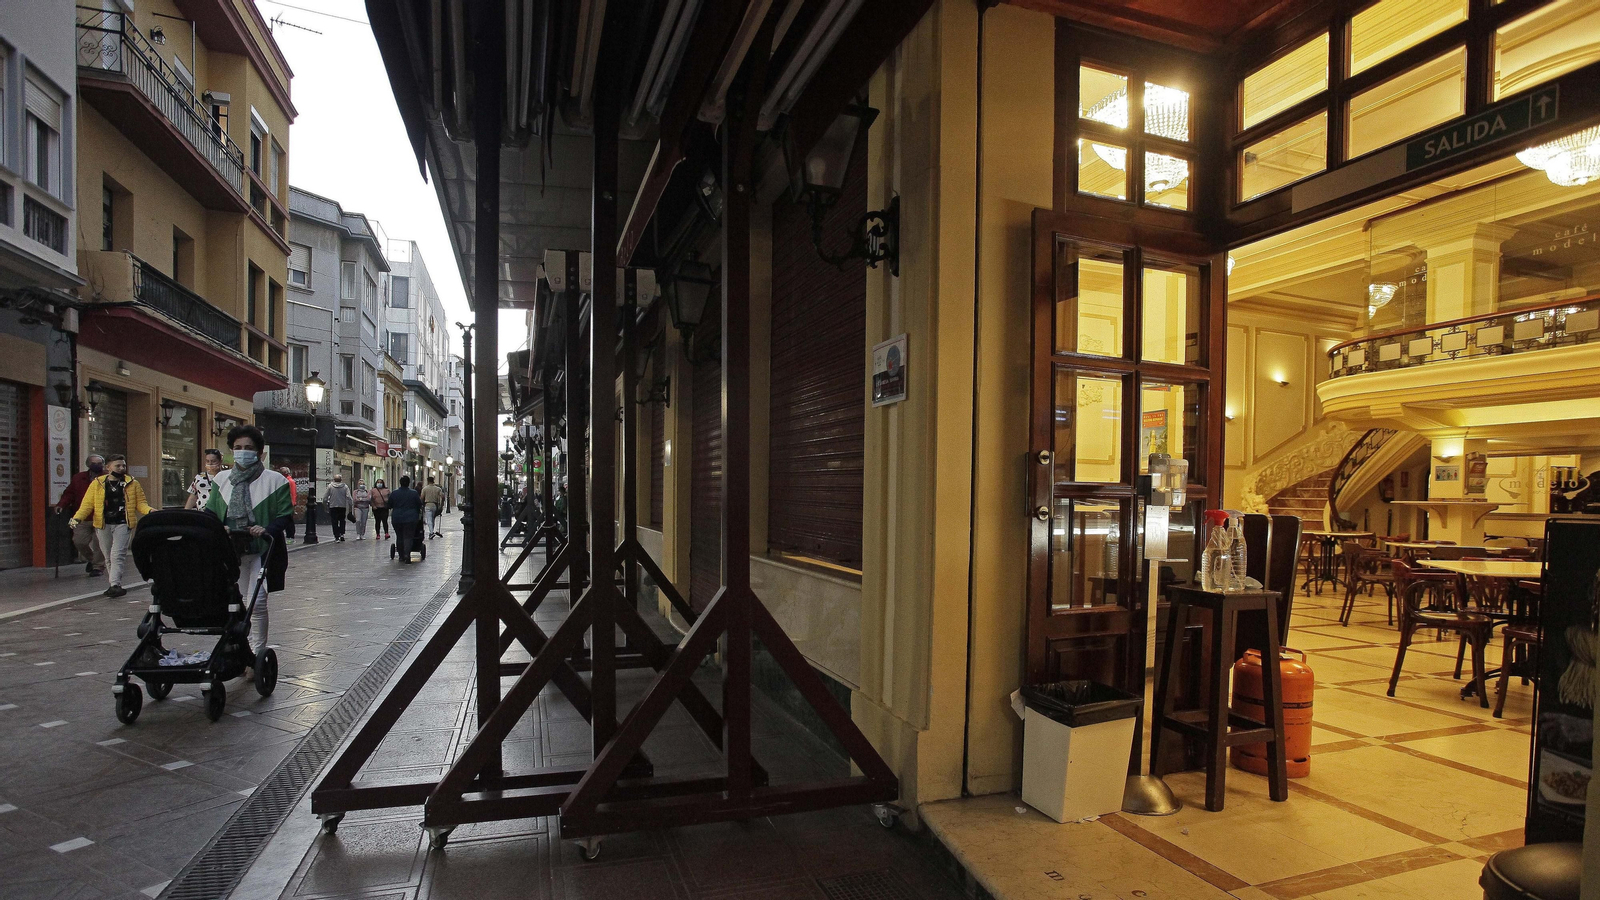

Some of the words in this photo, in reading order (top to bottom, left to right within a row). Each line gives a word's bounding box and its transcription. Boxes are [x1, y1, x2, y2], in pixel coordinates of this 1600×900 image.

[1425, 115, 1507, 159] SALIDA
[1554, 223, 1588, 238] café
[1509, 477, 1579, 489] modelo
